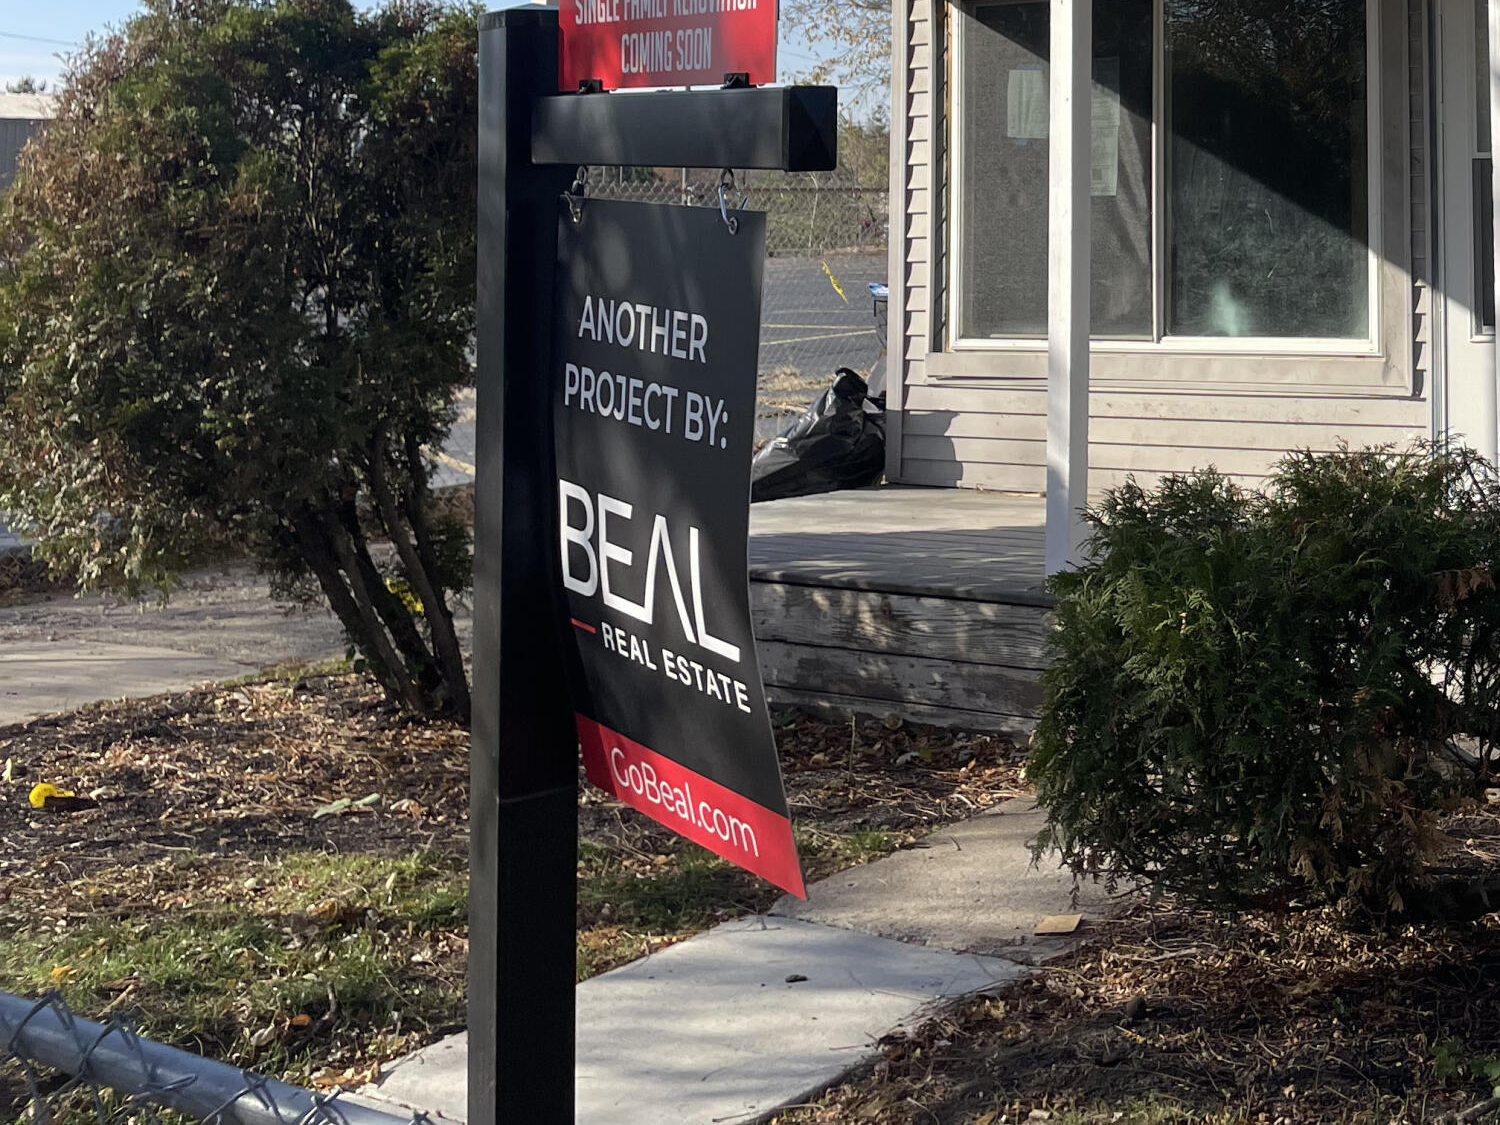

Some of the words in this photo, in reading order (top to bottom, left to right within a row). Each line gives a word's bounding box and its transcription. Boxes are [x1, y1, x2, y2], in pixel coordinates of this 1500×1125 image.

[621, 30, 672, 74] COMING
[676, 27, 712, 71] SOON
[578, 295, 708, 364] ANOTHER
[564, 362, 678, 434] PROJECT
[684, 391, 729, 449] BY:
[559, 478, 741, 663] BEAL
[601, 621, 657, 671] REAL
[661, 648, 751, 714] ESTATE
[610, 747, 760, 858] GoBeal.com
